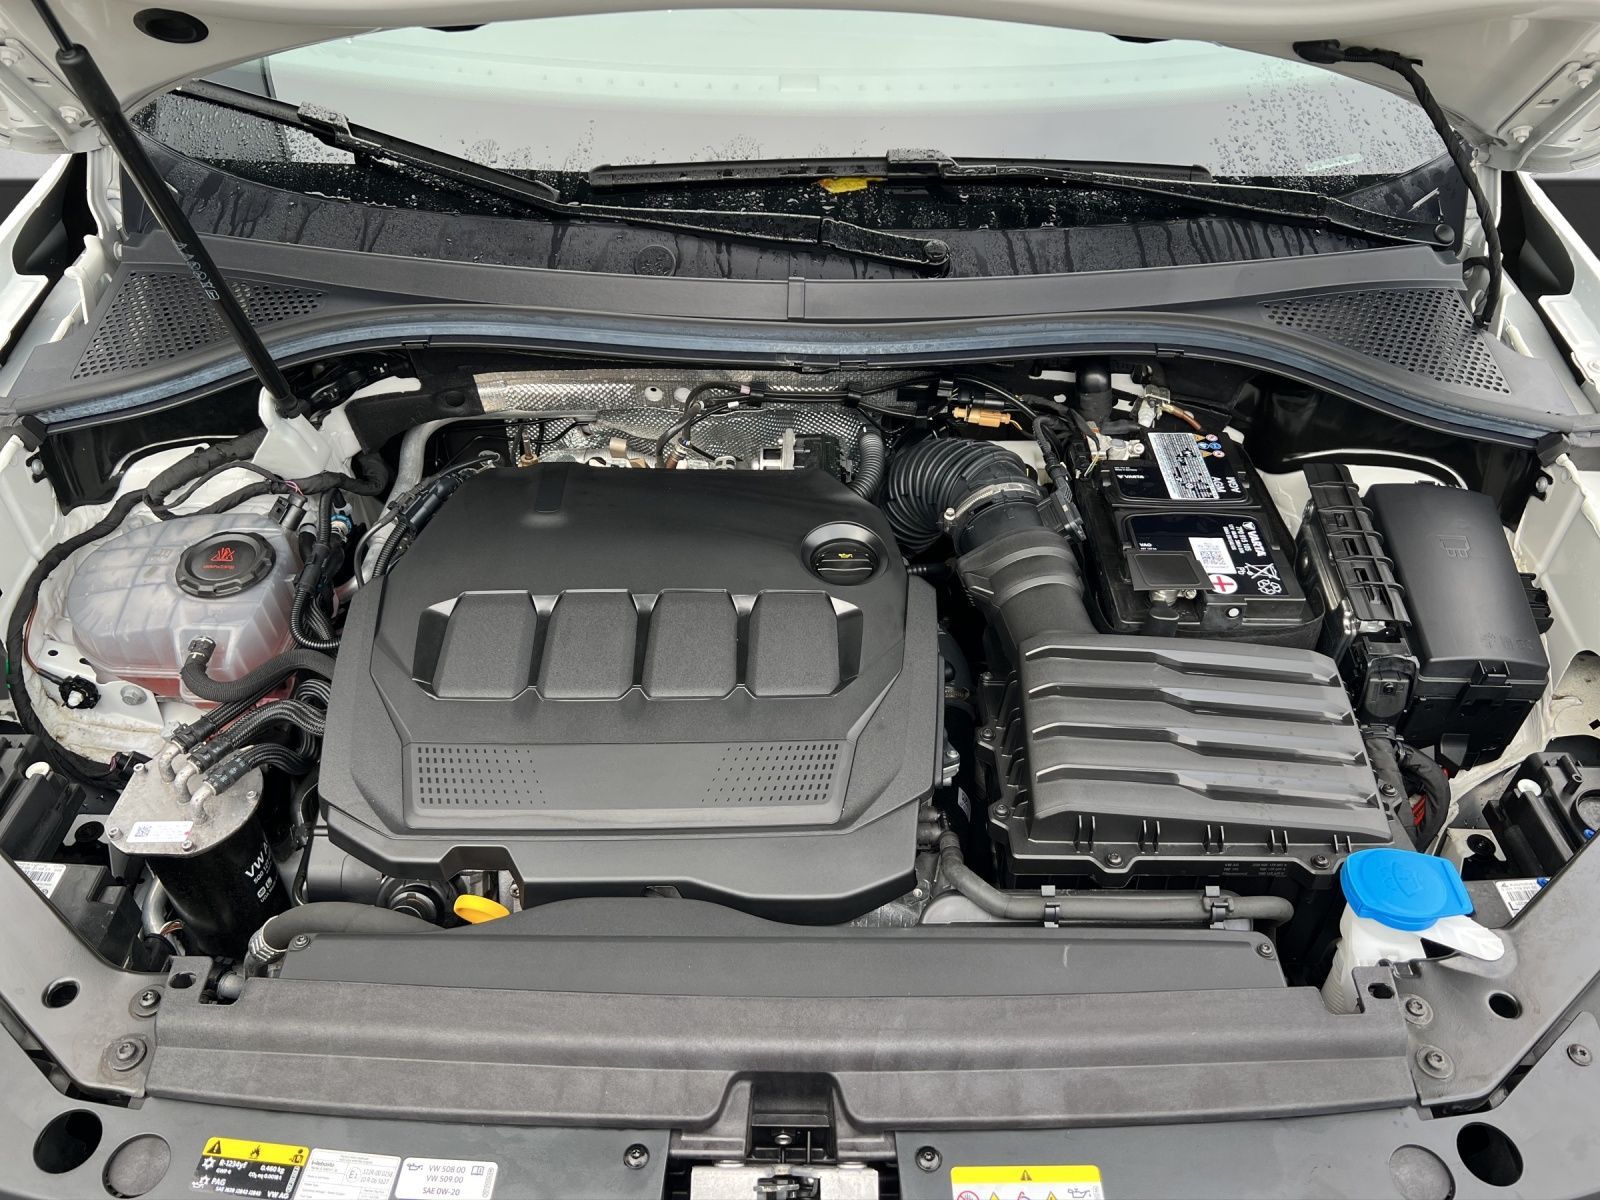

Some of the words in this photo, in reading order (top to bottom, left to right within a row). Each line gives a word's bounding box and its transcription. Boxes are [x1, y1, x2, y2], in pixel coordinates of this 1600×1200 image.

[1247, 530, 1267, 557] VARTA
[244, 851, 264, 877] VW
[218, 1159, 248, 1170] R-1234yf
[456, 1166, 466, 1174] 00
[211, 1177, 227, 1186] PAG
[267, 1190, 279, 1198] VW
[422, 1187, 437, 1195] SAE
